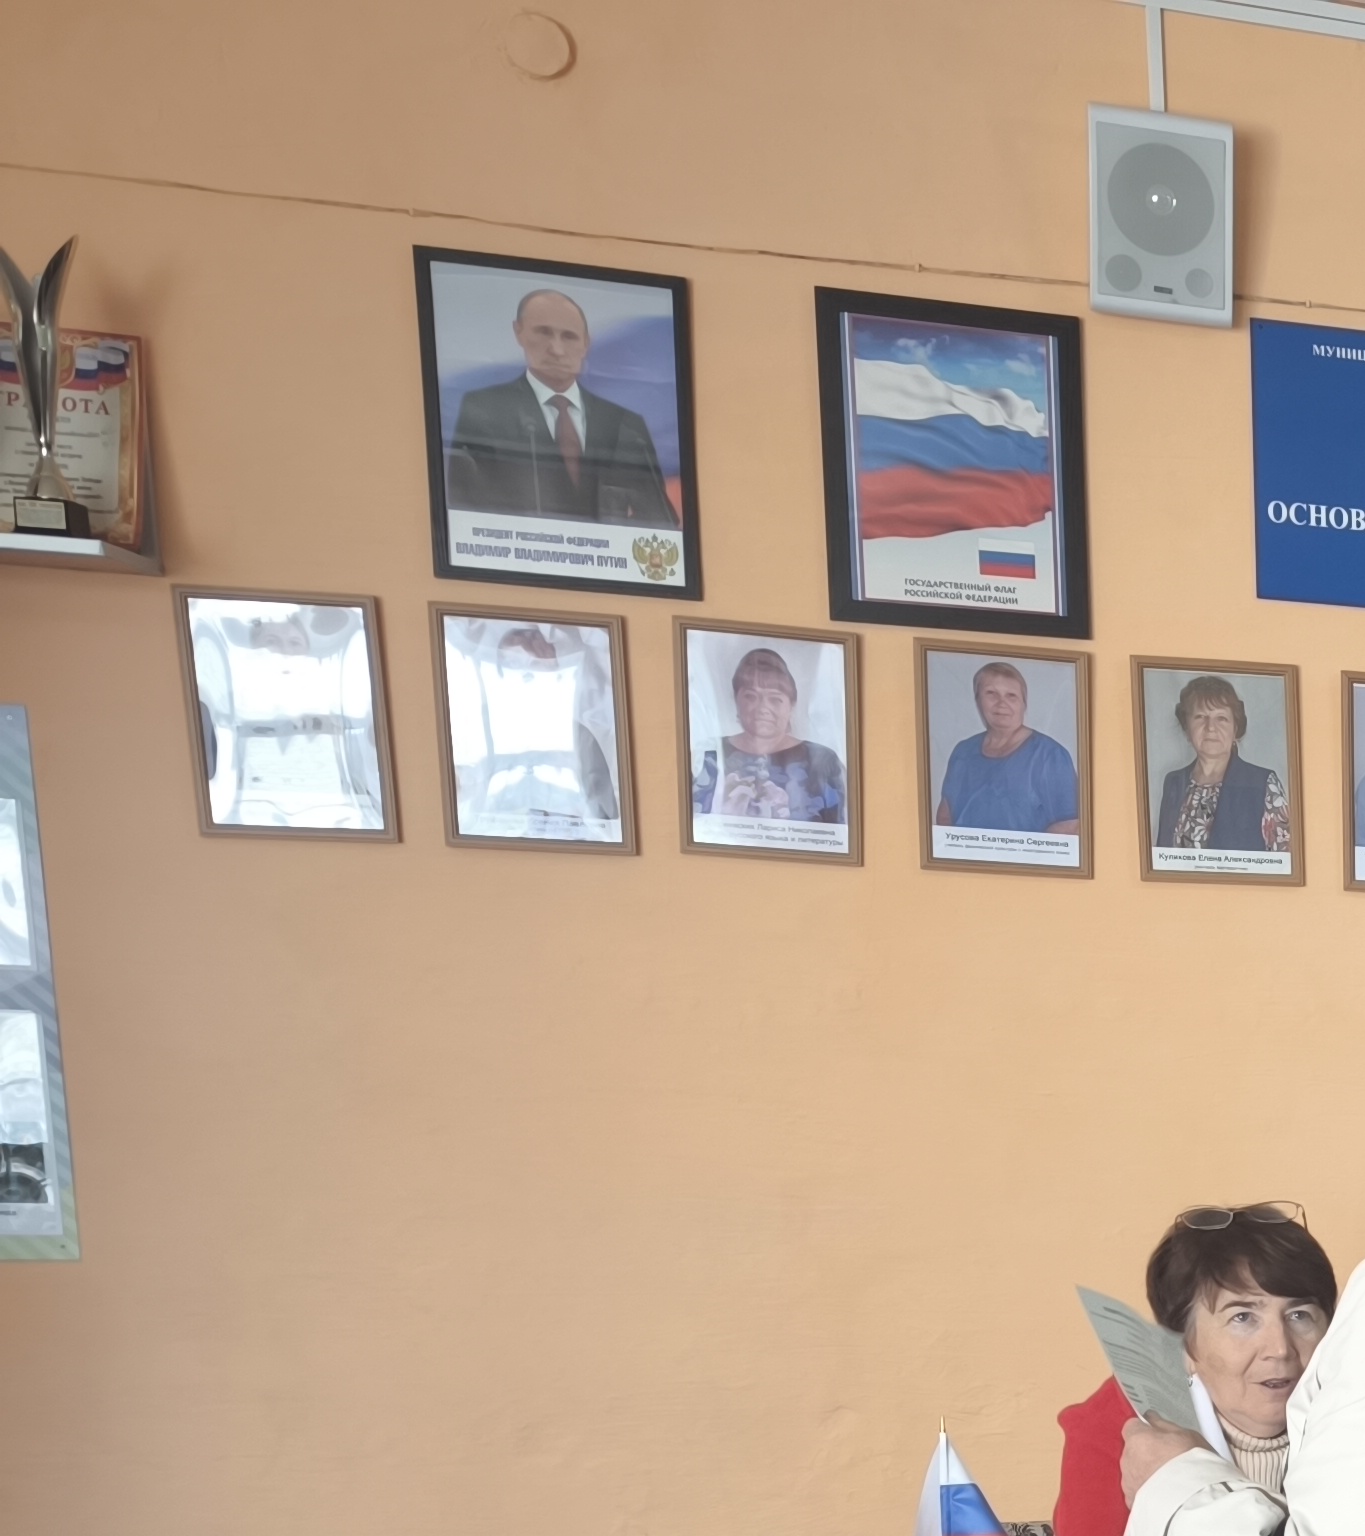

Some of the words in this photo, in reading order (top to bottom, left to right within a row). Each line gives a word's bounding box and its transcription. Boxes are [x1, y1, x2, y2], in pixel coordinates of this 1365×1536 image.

[455, 542, 511, 558] ВЛАДИМИР
[514, 547, 595, 567] ВЛАДИМИРОВИЧ
[596, 554, 628, 569] ПУТИН
[904, 578, 992, 592] ГОСУДАРСТВЕННЫЙ
[993, 585, 1017, 594] ФЛАГ
[904, 589, 962, 600] РОССИЙСКОЙ
[965, 594, 1019, 605] ФЕДЕРАЦИИ
